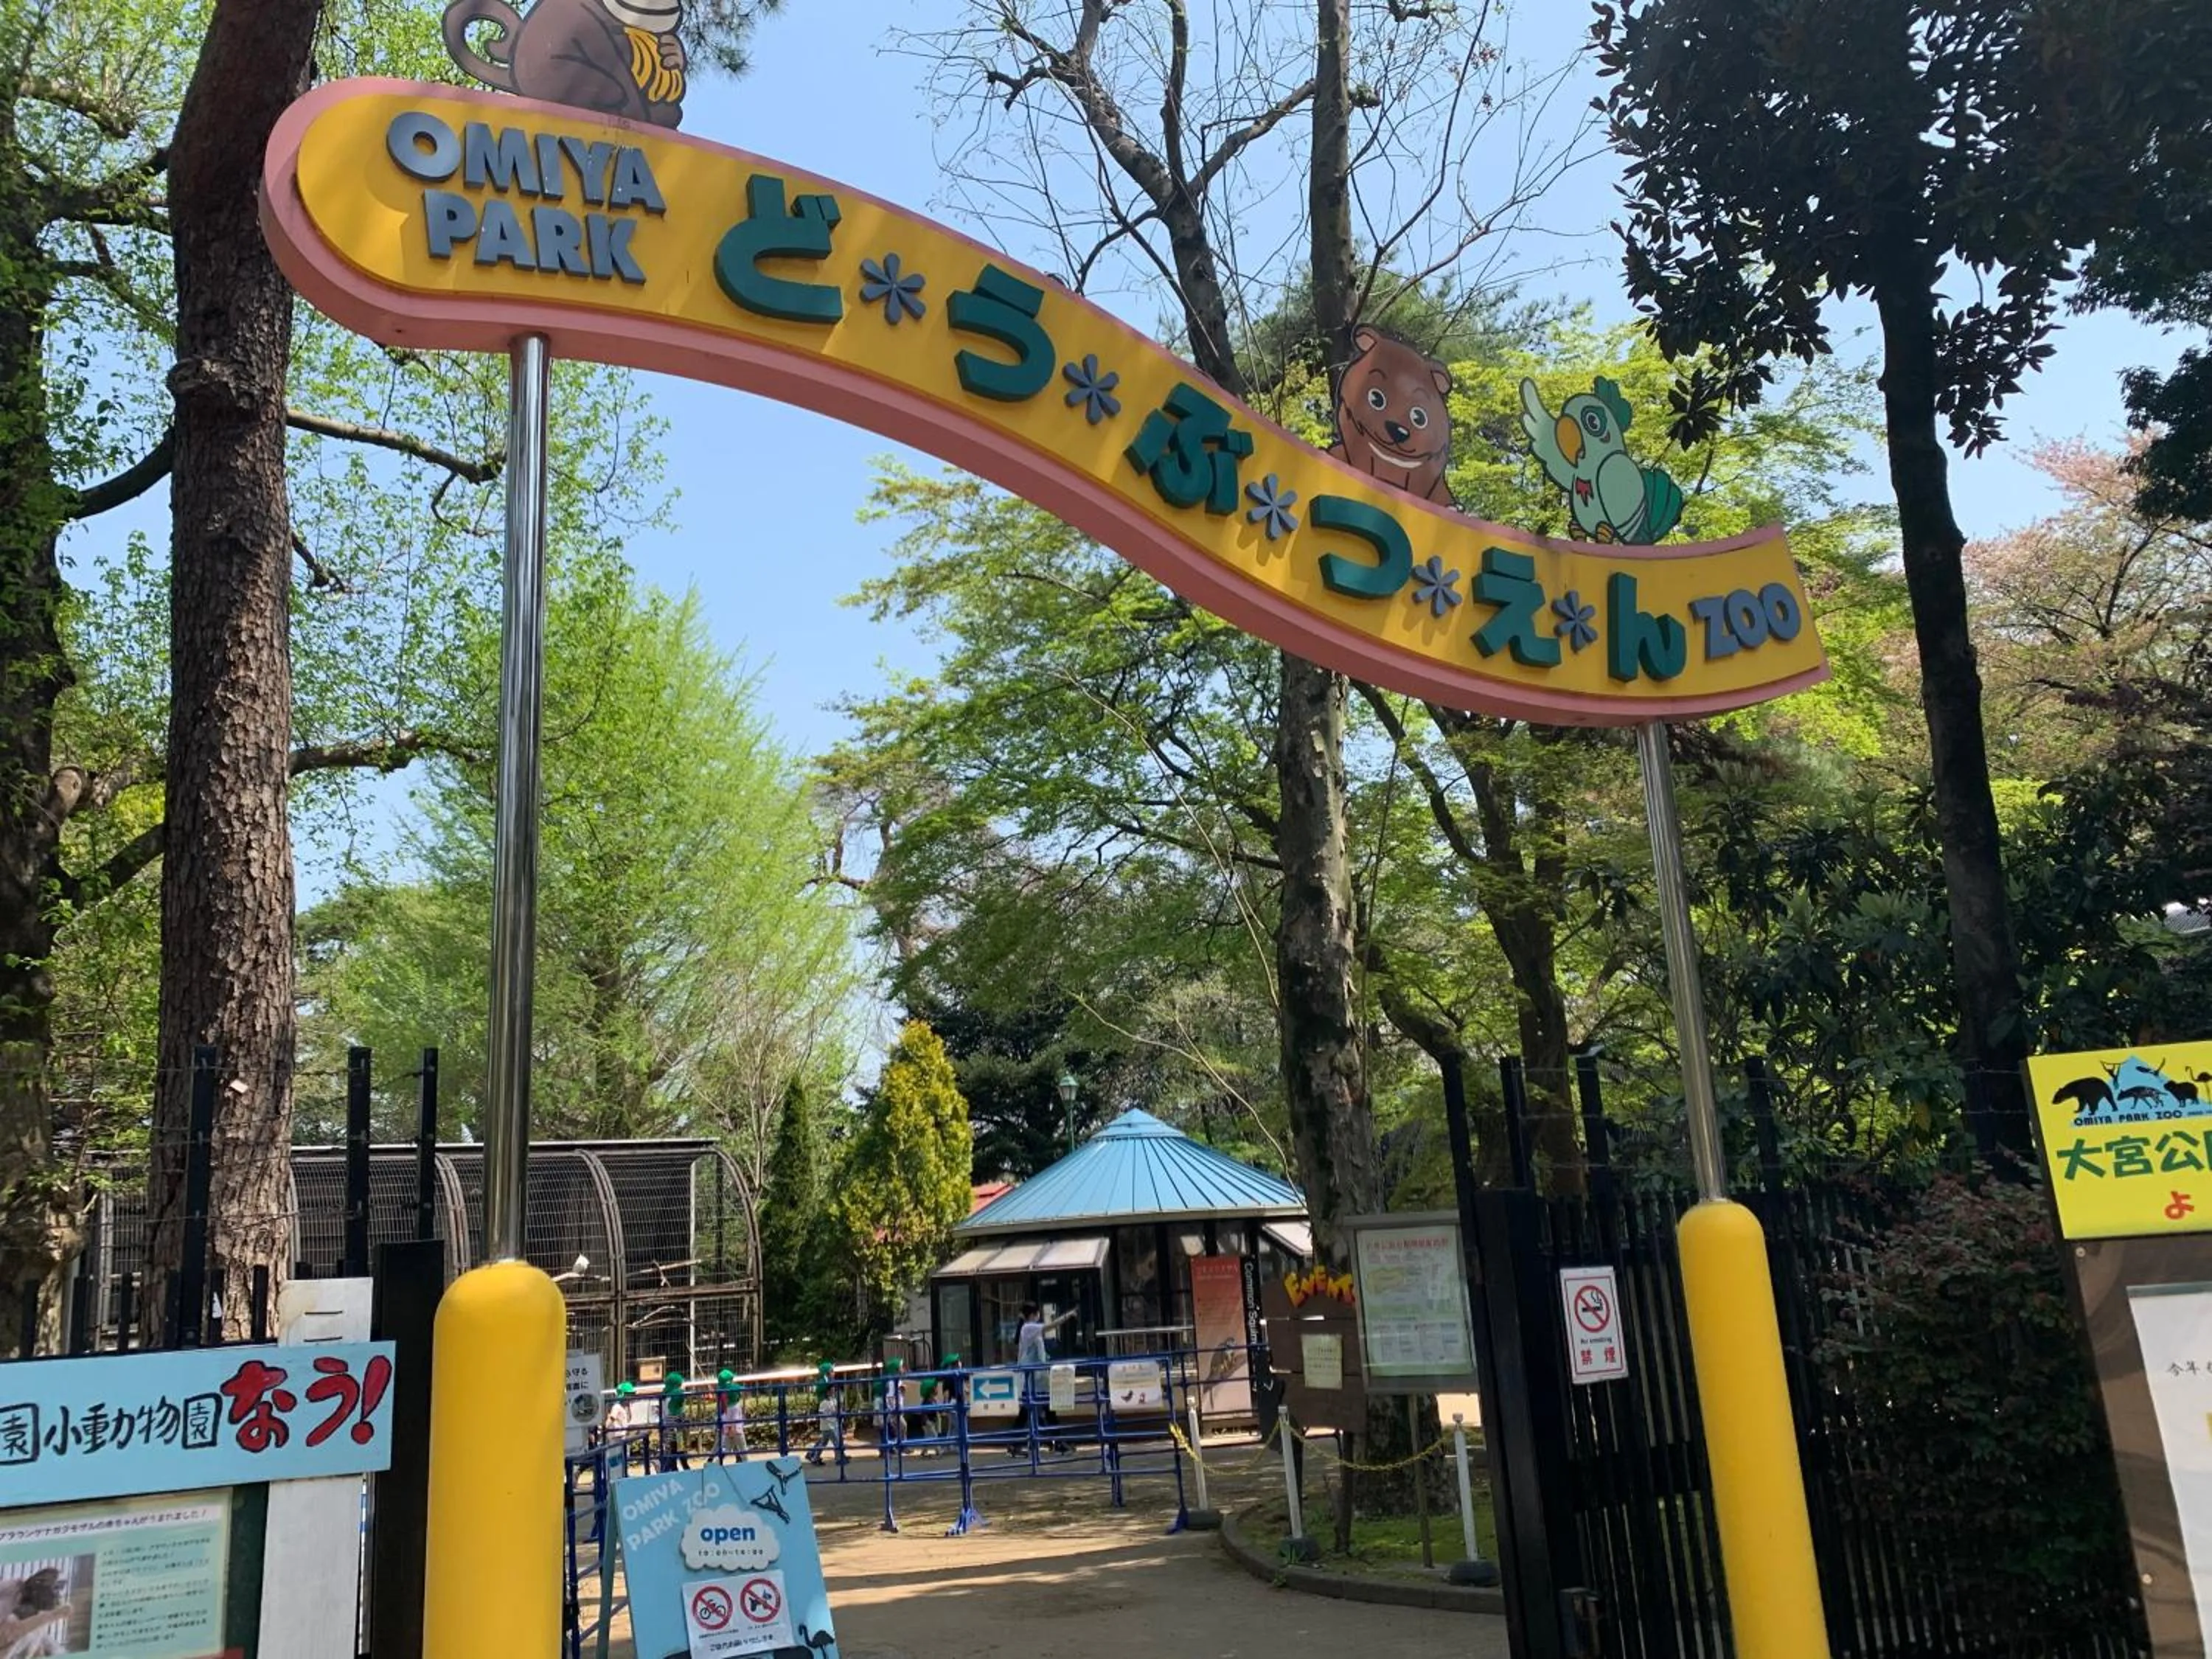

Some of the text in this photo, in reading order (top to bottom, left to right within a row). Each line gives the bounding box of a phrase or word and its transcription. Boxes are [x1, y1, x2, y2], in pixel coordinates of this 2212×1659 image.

[386, 111, 666, 217] OMIYA
[422, 189, 646, 285] PARK
[1688, 582, 1801, 661] ZOO
[2073, 1115, 2112, 1126] OMIYA
[2118, 1112, 2149, 1123] PARK
[2155, 1110, 2183, 1120] ZOO
[2056, 1130, 2212, 1180] 大宮公
[2164, 1191, 2195, 1220] よ
[622, 1478, 684, 1520] OMIYA
[626, 1482, 720, 1551] PARK ZOO
[700, 1527, 755, 1545] open
